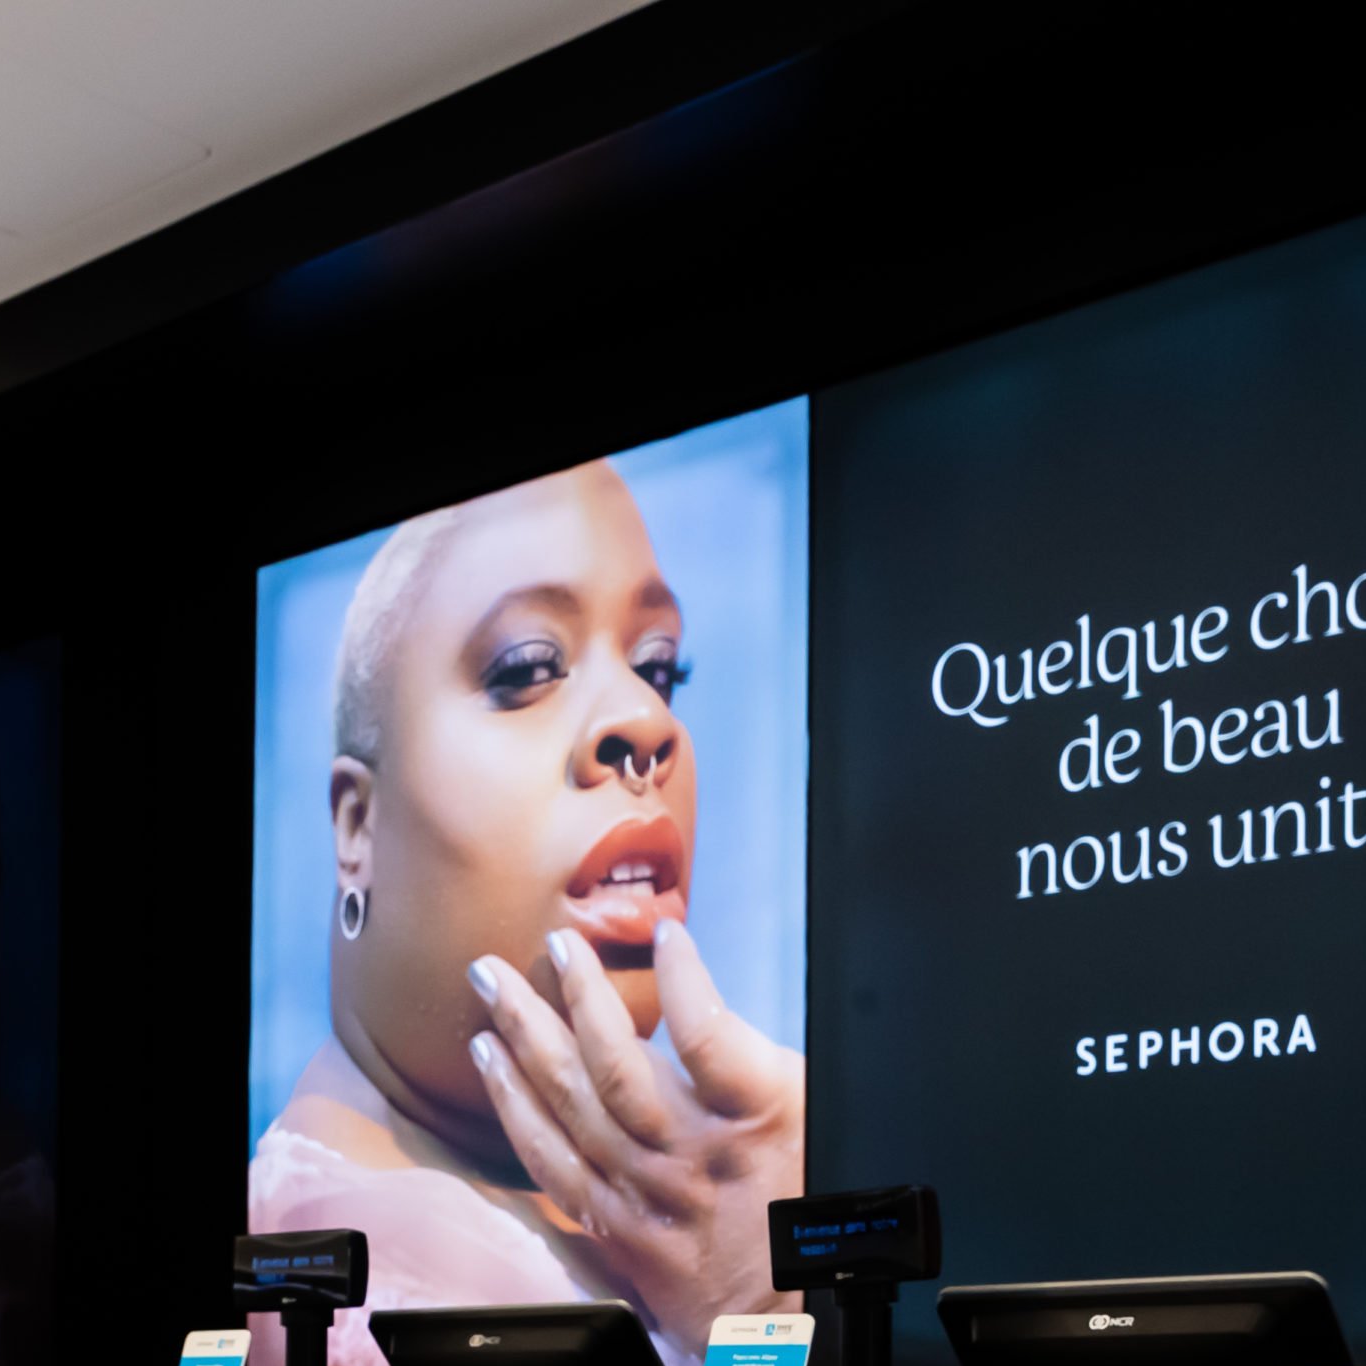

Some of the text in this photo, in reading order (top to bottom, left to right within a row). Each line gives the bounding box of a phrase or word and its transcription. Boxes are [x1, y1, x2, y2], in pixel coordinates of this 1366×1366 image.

[931, 605, 1230, 728] Quelque
[1059, 688, 1345, 793] de beau
[1015, 821, 1189, 900] nous
[1075, 1013, 1317, 1077] SEPHORA
